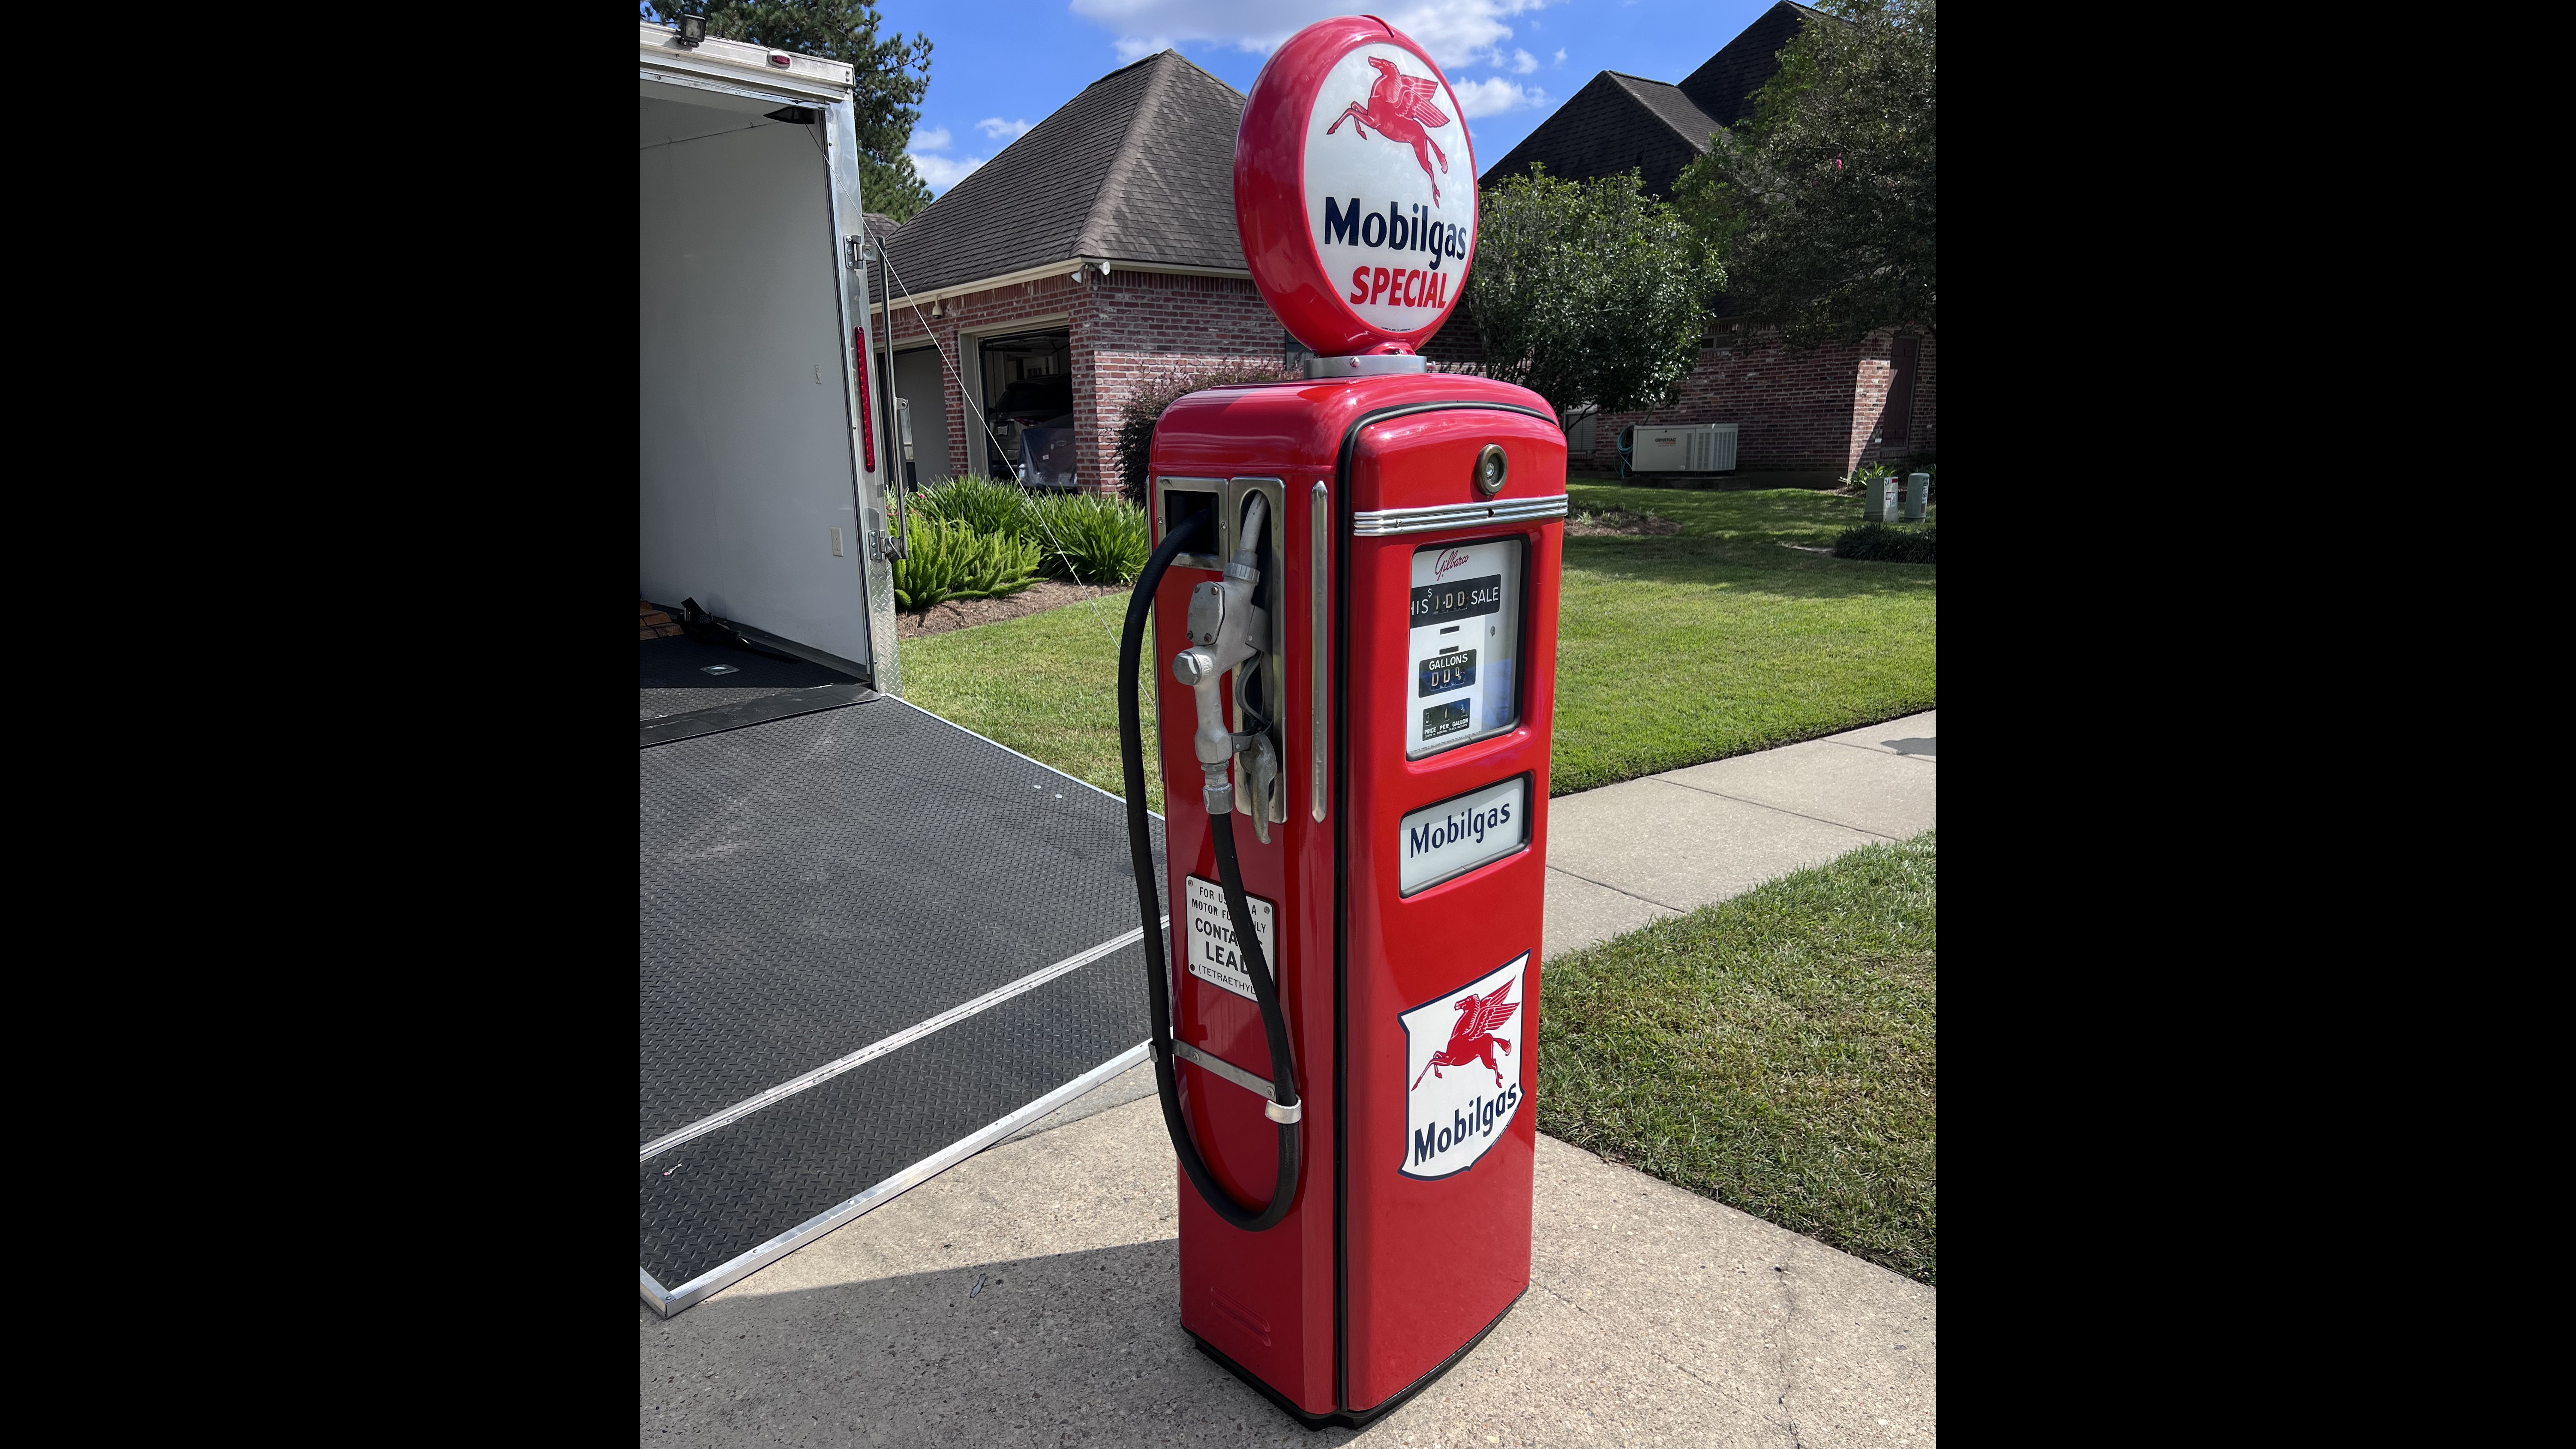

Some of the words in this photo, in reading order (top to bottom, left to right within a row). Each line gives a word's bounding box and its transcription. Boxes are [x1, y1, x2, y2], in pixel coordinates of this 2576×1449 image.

[1324, 196, 1466, 270] Mobilgas
[1350, 266, 1447, 309] SPECIAL
[1435, 549, 1469, 581] Gilbarco
[1411, 599, 1429, 616] HIS
[1471, 586, 1499, 605] SALE
[1429, 653, 1468, 670] GALLONS
[1424, 727, 1436, 735] PRICE
[1452, 718, 1468, 727] GALLON
[1411, 803, 1510, 858] Mobilgas
[1192, 898, 1218, 916] MOTOR
[1222, 909, 1231, 921] FU
[1199, 886, 1214, 900] FOR
[1252, 905, 1257, 915] A
[1414, 1082, 1517, 1167] Mobilgas
